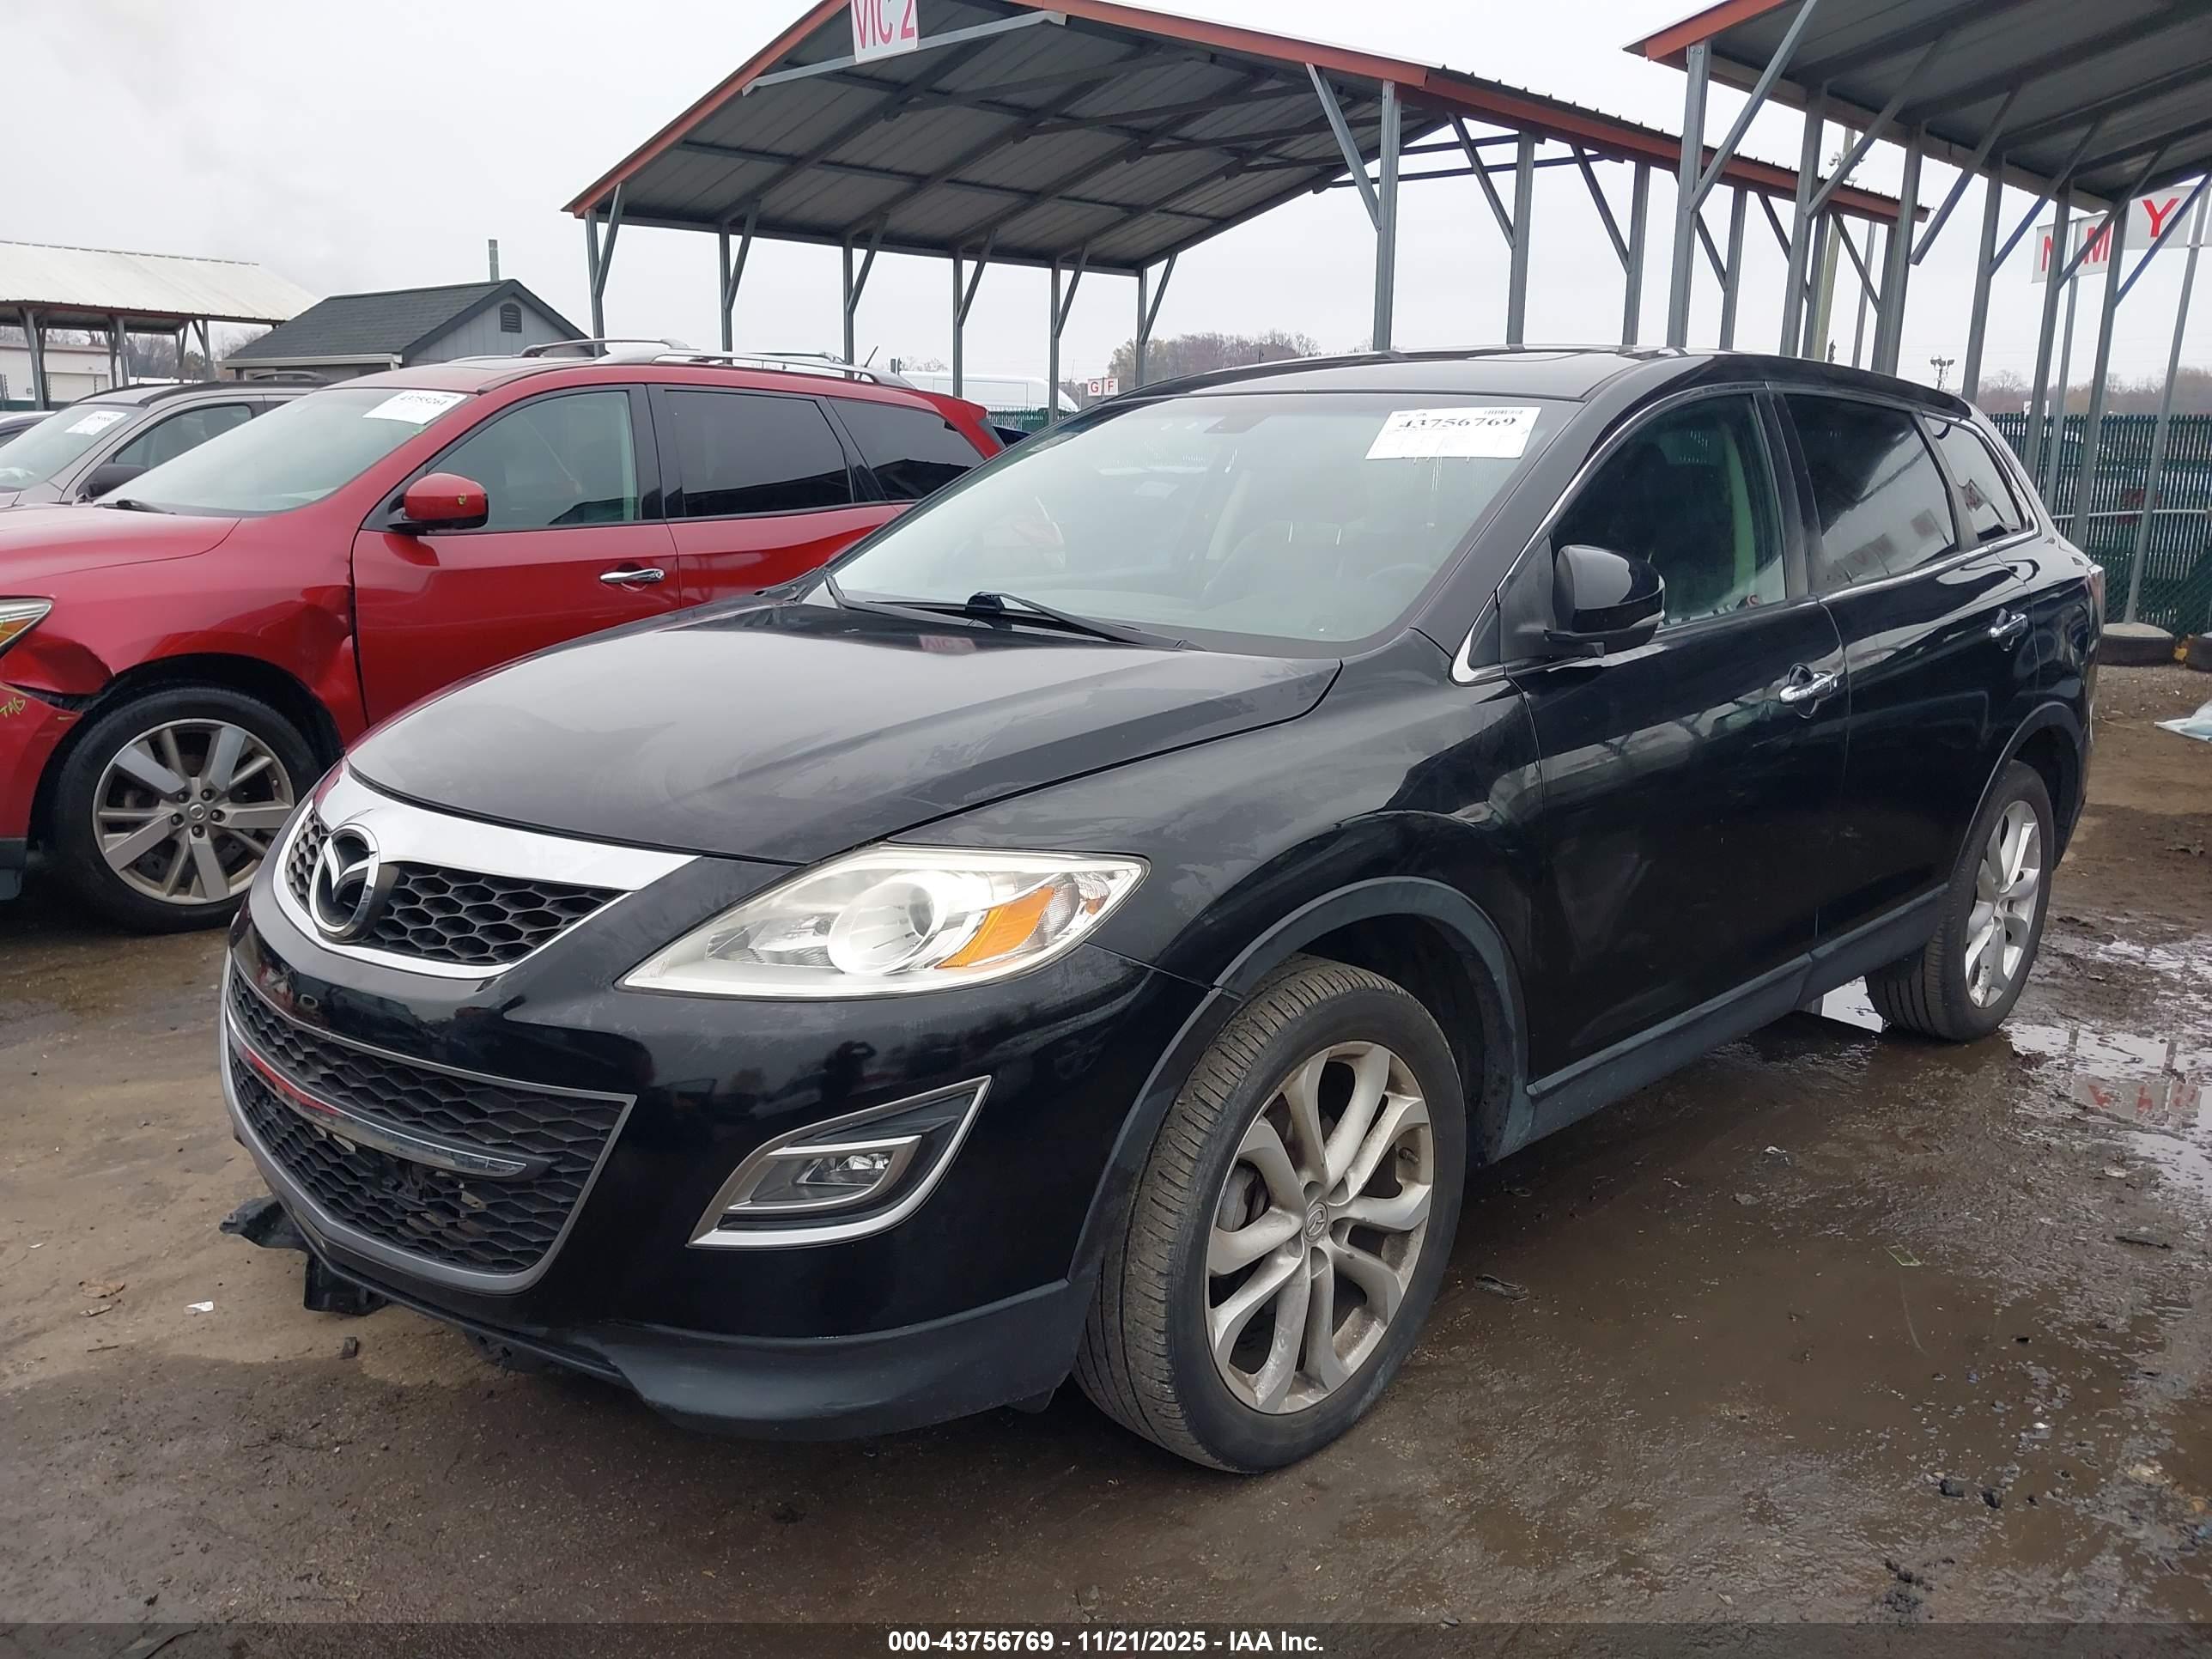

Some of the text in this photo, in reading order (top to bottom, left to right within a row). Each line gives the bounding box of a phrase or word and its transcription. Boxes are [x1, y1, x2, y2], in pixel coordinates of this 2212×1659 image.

[851, 0, 915, 49] VIC 2
[2142, 198, 2179, 238] Y
[2083, 226, 2112, 265] M
[1091, 381, 1099, 393] G
[1108, 380, 1115, 392] F
[1399, 417, 1516, 428] 43756769
